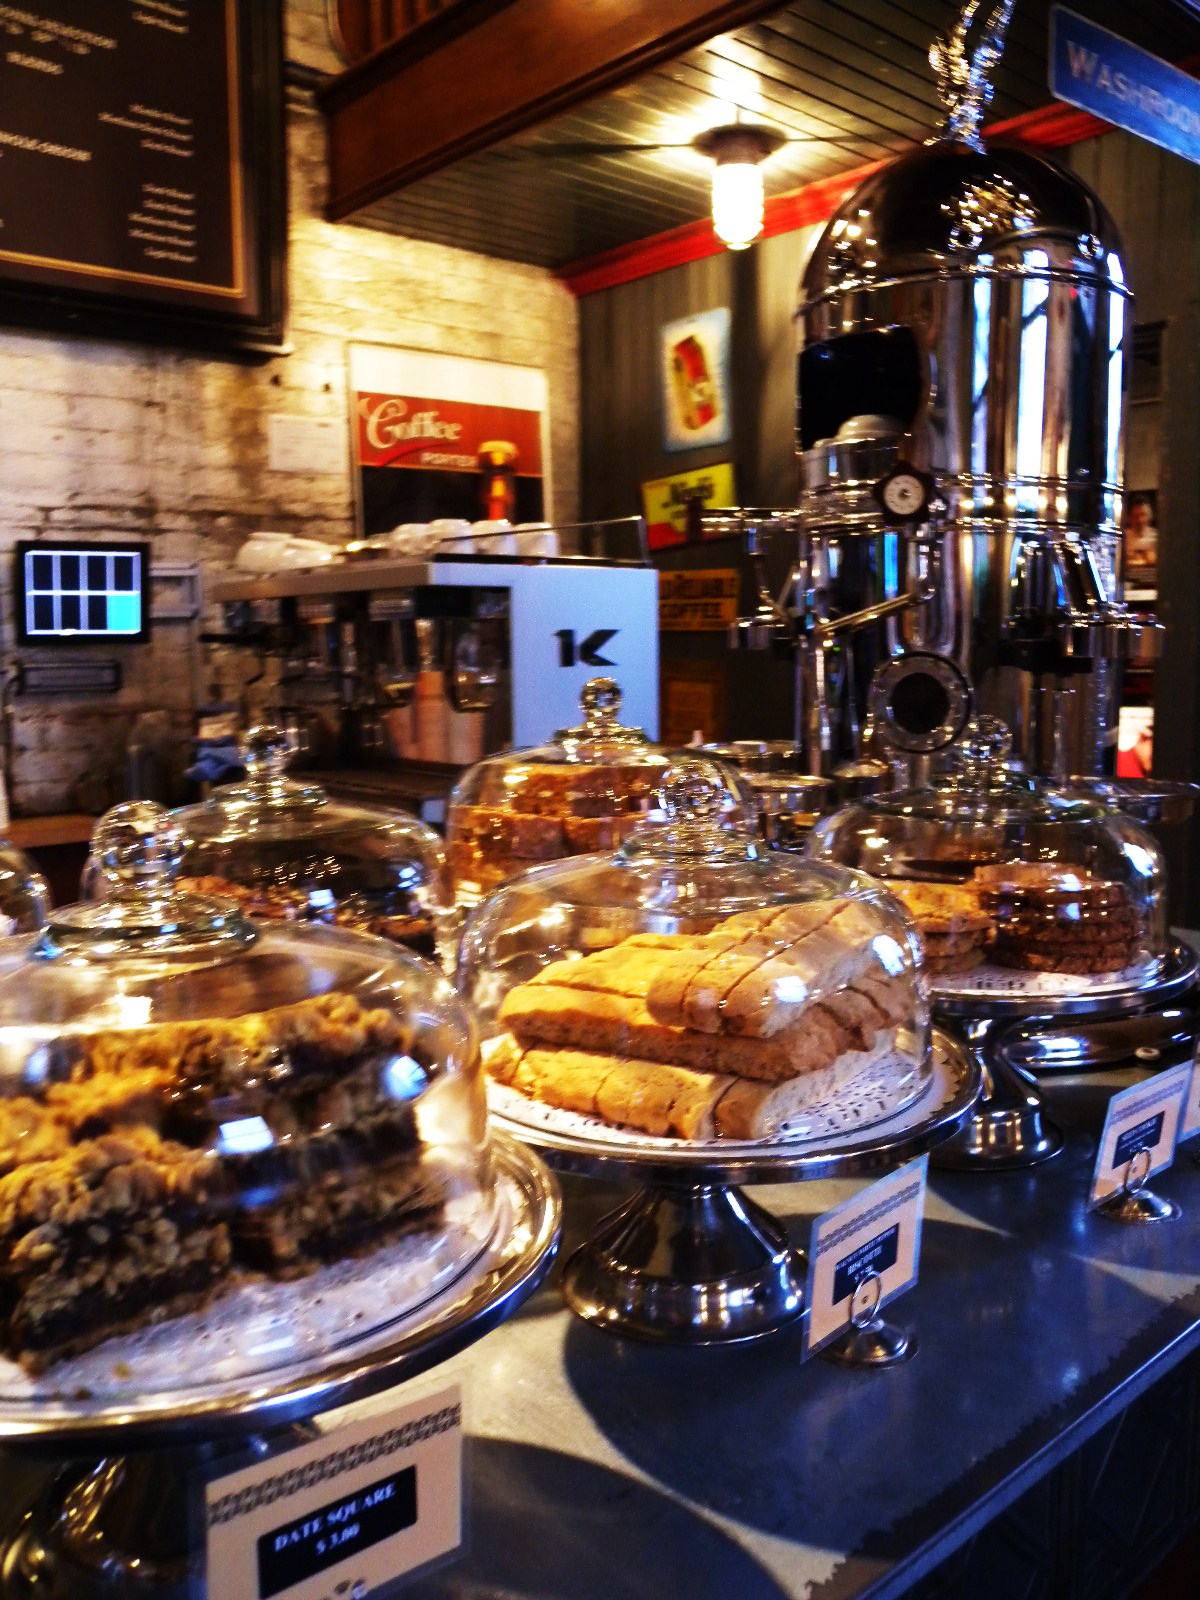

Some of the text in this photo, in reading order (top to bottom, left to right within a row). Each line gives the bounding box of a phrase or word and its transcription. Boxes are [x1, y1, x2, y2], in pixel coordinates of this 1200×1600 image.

[358, 397, 463, 449] Coffee
[274, 1482, 397, 1552] DATE SQUARE
